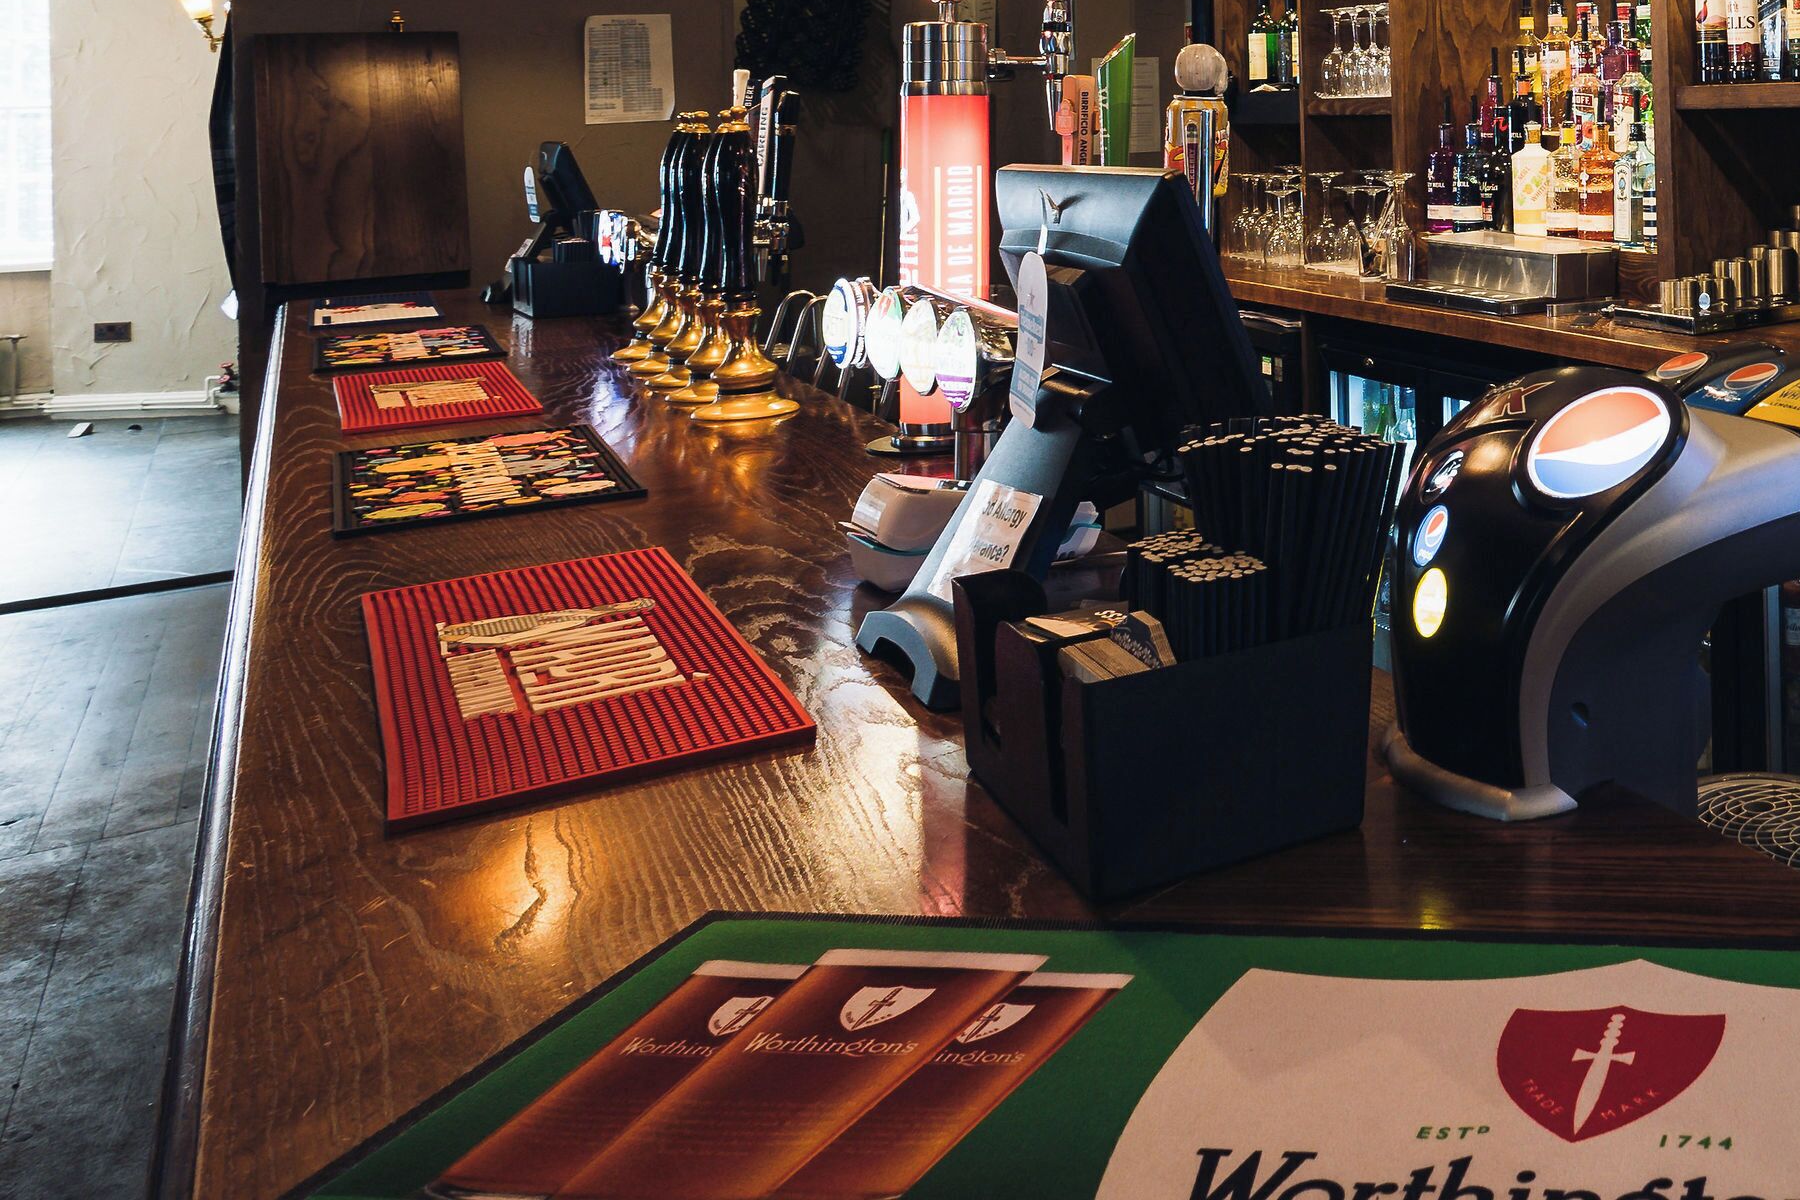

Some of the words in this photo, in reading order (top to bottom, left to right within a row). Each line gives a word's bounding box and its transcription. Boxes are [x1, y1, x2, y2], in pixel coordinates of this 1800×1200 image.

[1079, 91, 1089, 136] BIRRIFICIO
[757, 107, 769, 167] CARLING
[947, 165, 974, 239] MADRID
[947, 244, 974, 267] DE
[994, 500, 1028, 529] Allergy
[744, 1031, 920, 1056] Worthington's
[933, 1048, 1026, 1066] ington's
[1520, 1077, 1564, 1117] TRADE
[1600, 1087, 1662, 1121] MARK
[1658, 1135, 1734, 1151] 1744
